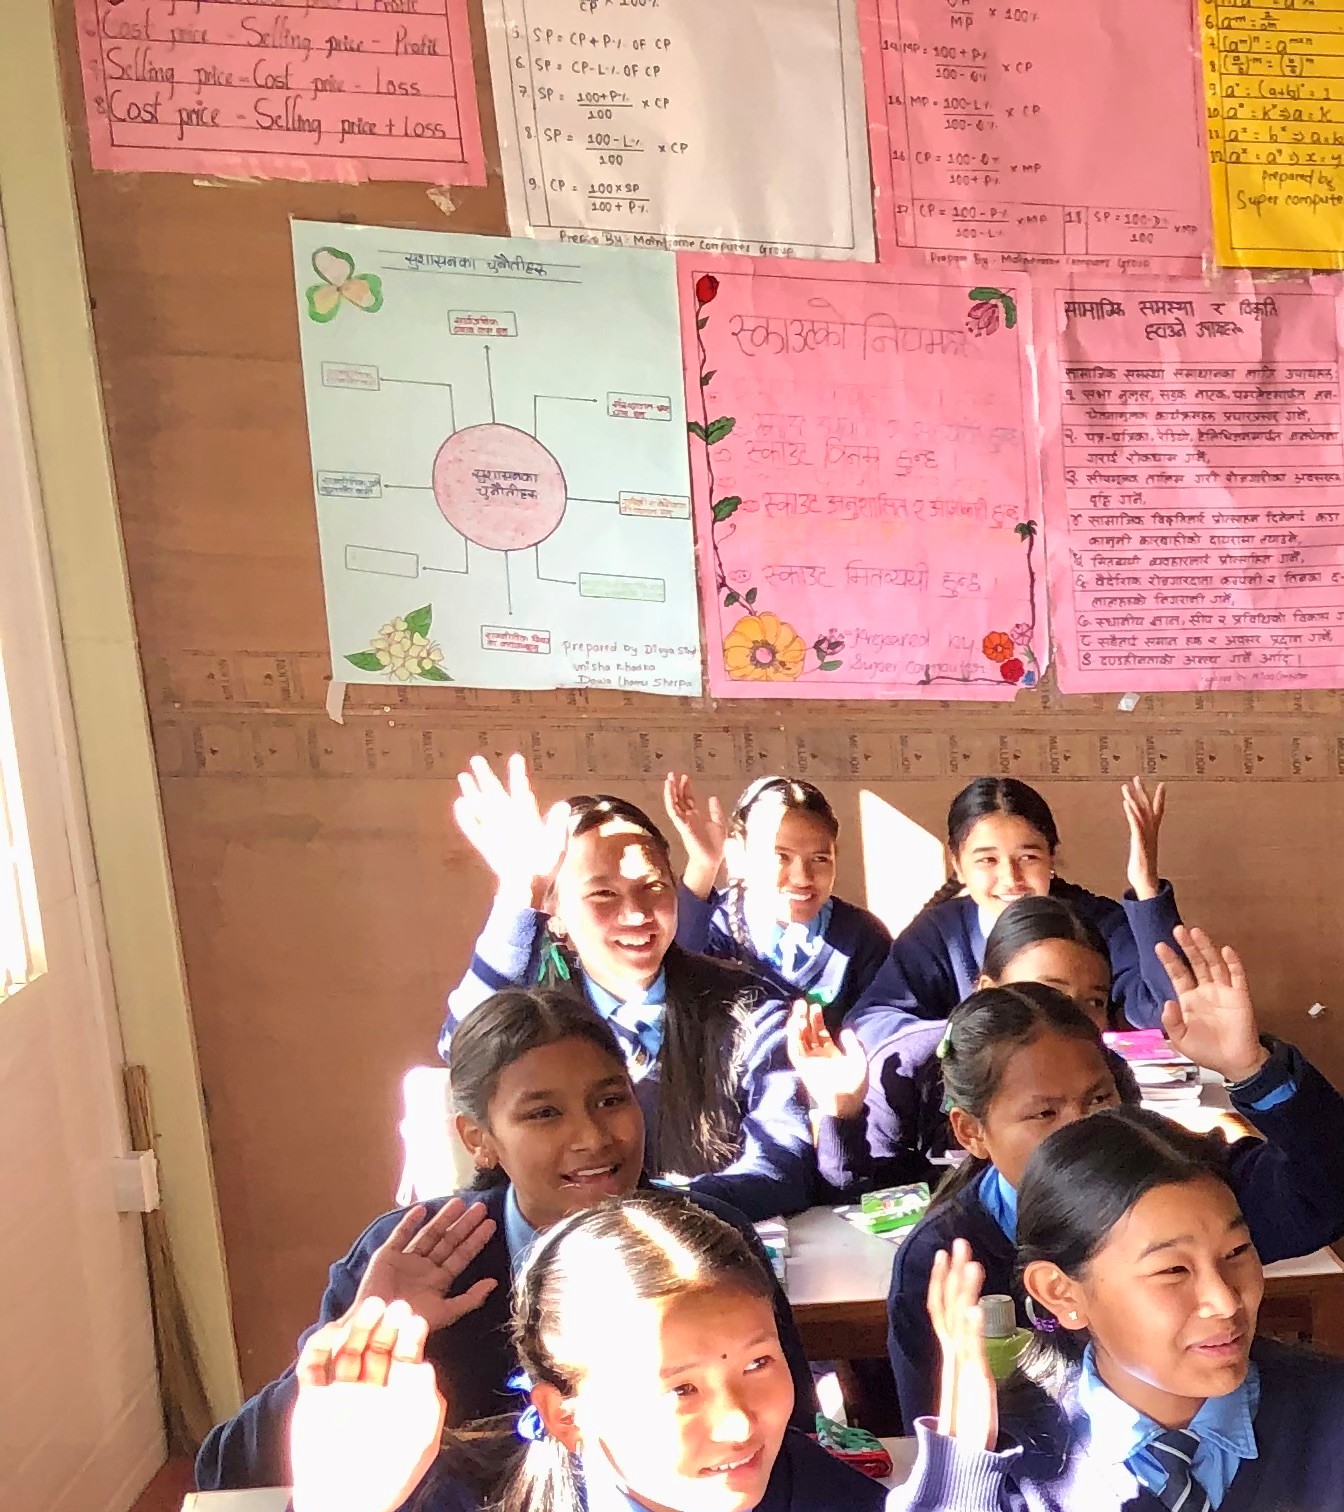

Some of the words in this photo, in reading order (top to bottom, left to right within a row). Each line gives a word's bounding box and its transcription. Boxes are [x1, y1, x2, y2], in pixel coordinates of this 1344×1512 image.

[105, 47, 175, 99] Selling
[252, 59, 293, 90] Cost
[375, 66, 421, 96] Loss
[107, 89, 162, 124] Cost
[254, 97, 322, 144] Selling
[403, 117, 447, 139] Loss
[1236, 190, 1279, 217] Super
